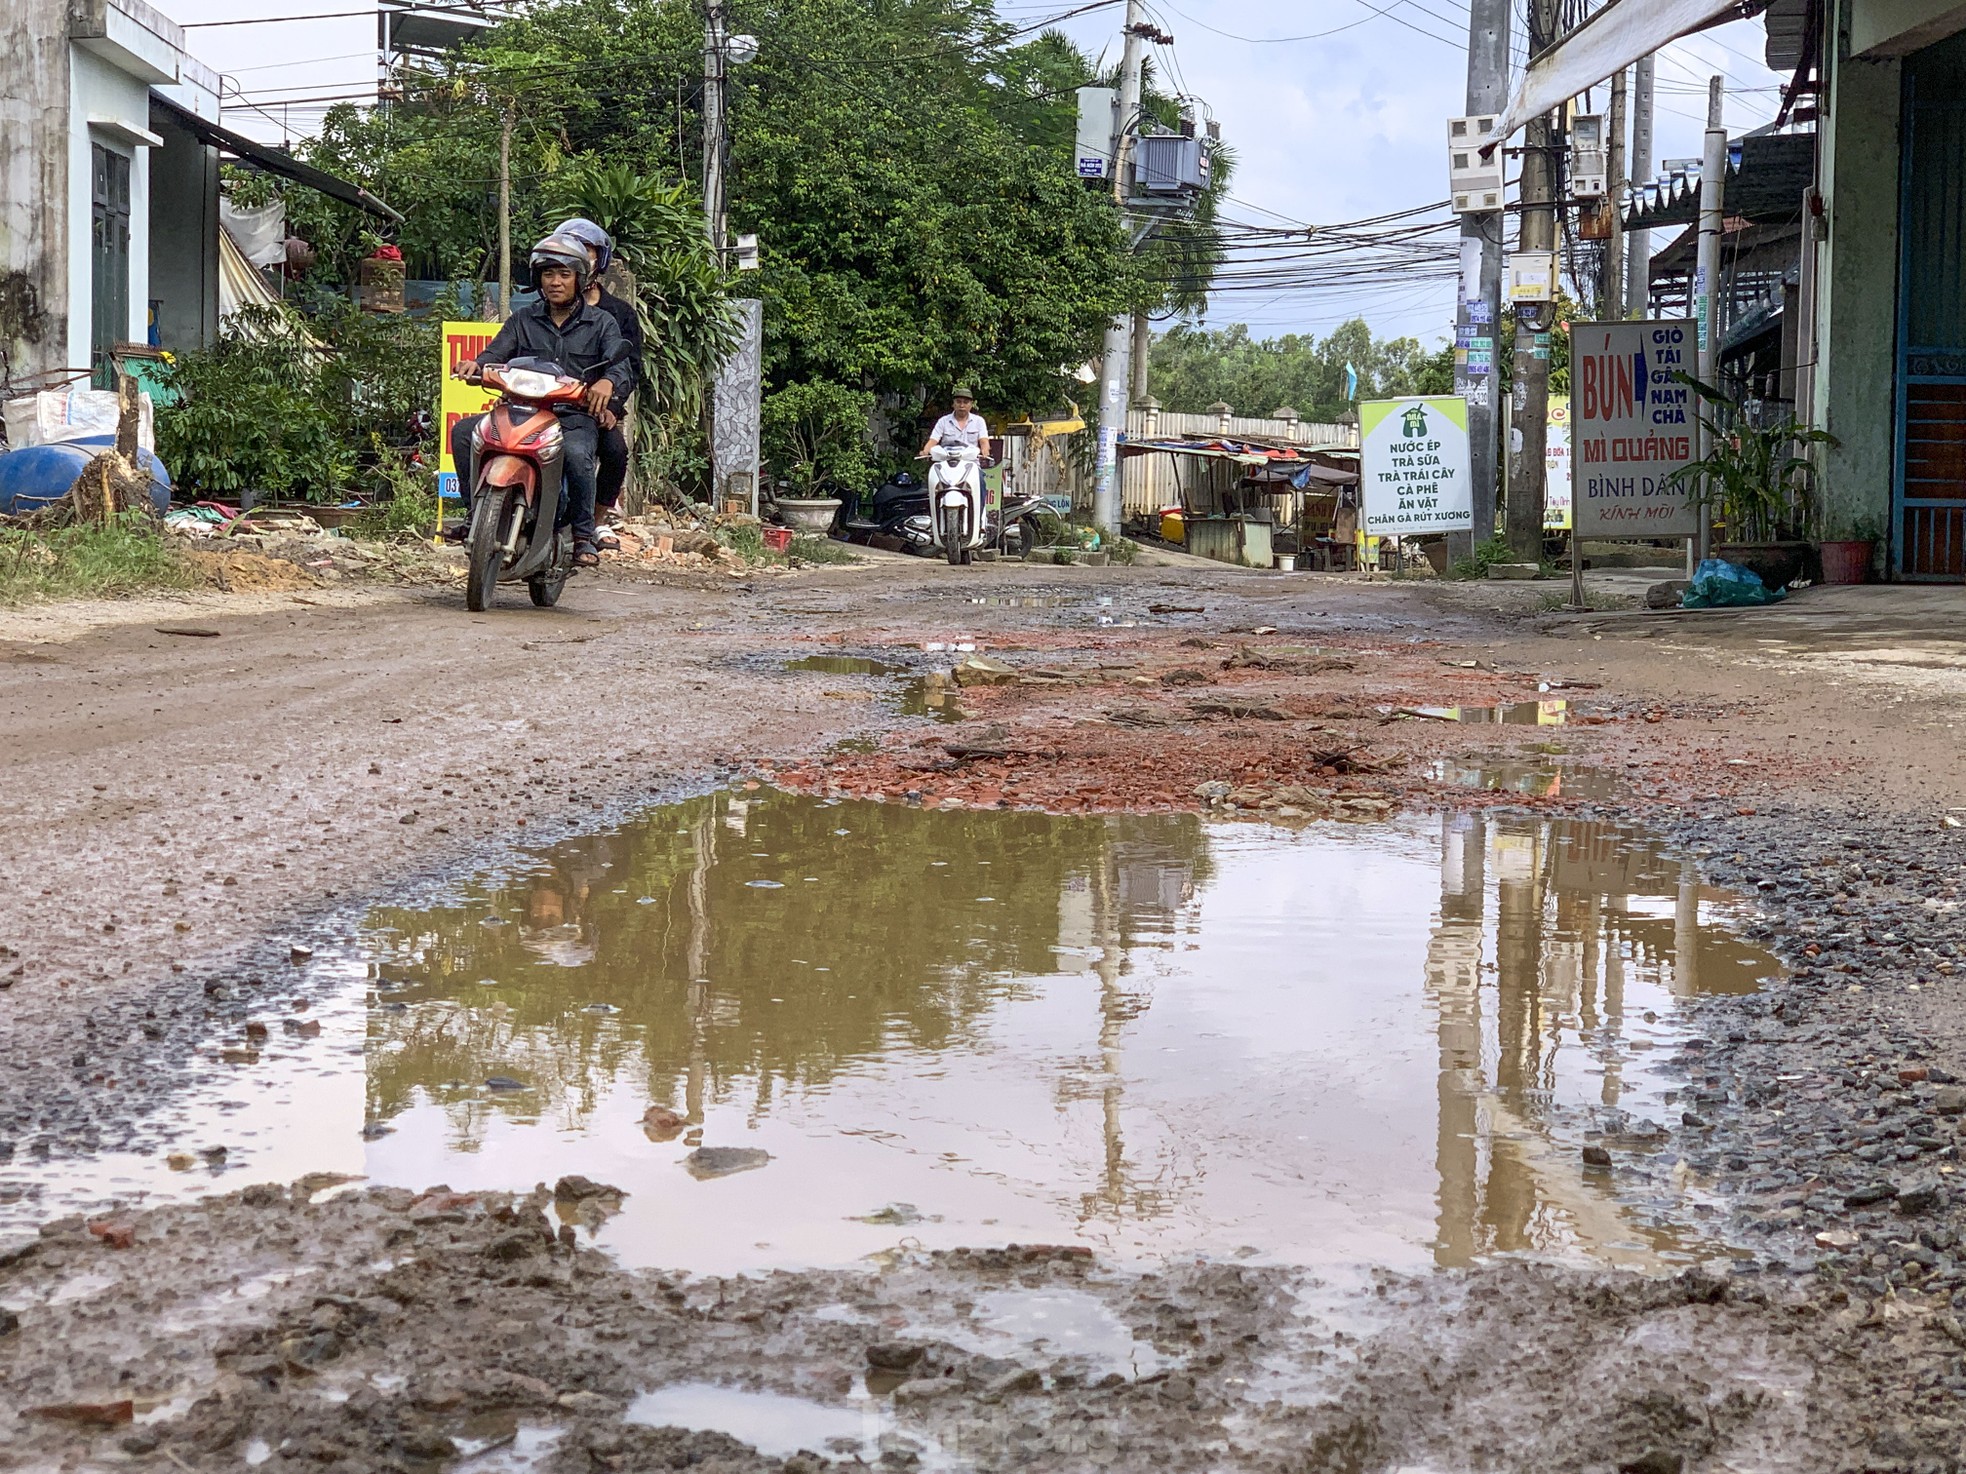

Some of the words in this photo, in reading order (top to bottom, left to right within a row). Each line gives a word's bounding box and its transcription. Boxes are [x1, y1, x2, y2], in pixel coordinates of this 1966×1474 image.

[1652, 326, 1683, 344] GIÒ
[1656, 346, 1680, 364] TÁI
[1583, 333, 1633, 421] BÚN
[1652, 404, 1686, 424] CHẢ
[1390, 440, 1424, 453] NƯỚC
[1427, 439, 1441, 451] ÉP
[1583, 430, 1607, 463] MÌ
[1612, 429, 1689, 462] QUẢNG
[1392, 455, 1415, 467] TRÀ
[1417, 454, 1440, 466] SỮA
[1378, 470, 1401, 482] TRÀ
[1403, 469, 1430, 481] TRÁI
[1432, 467, 1455, 479] CÂY
[1397, 484, 1414, 496] CÀ
[1416, 482, 1438, 494] PHÊ
[1588, 473, 1634, 498] BÌNH
[1642, 473, 1685, 496] DÂN
[1398, 498, 1414, 509] ĂN
[1417, 497, 1438, 511] VẬT
[1600, 504, 1641, 520] KÍNH
[1368, 514, 1395, 524] CHÂN
[1397, 512, 1412, 523] GÀ
[1414, 512, 1432, 521] RÚT
[1434, 511, 1470, 520] XƯƠNG
